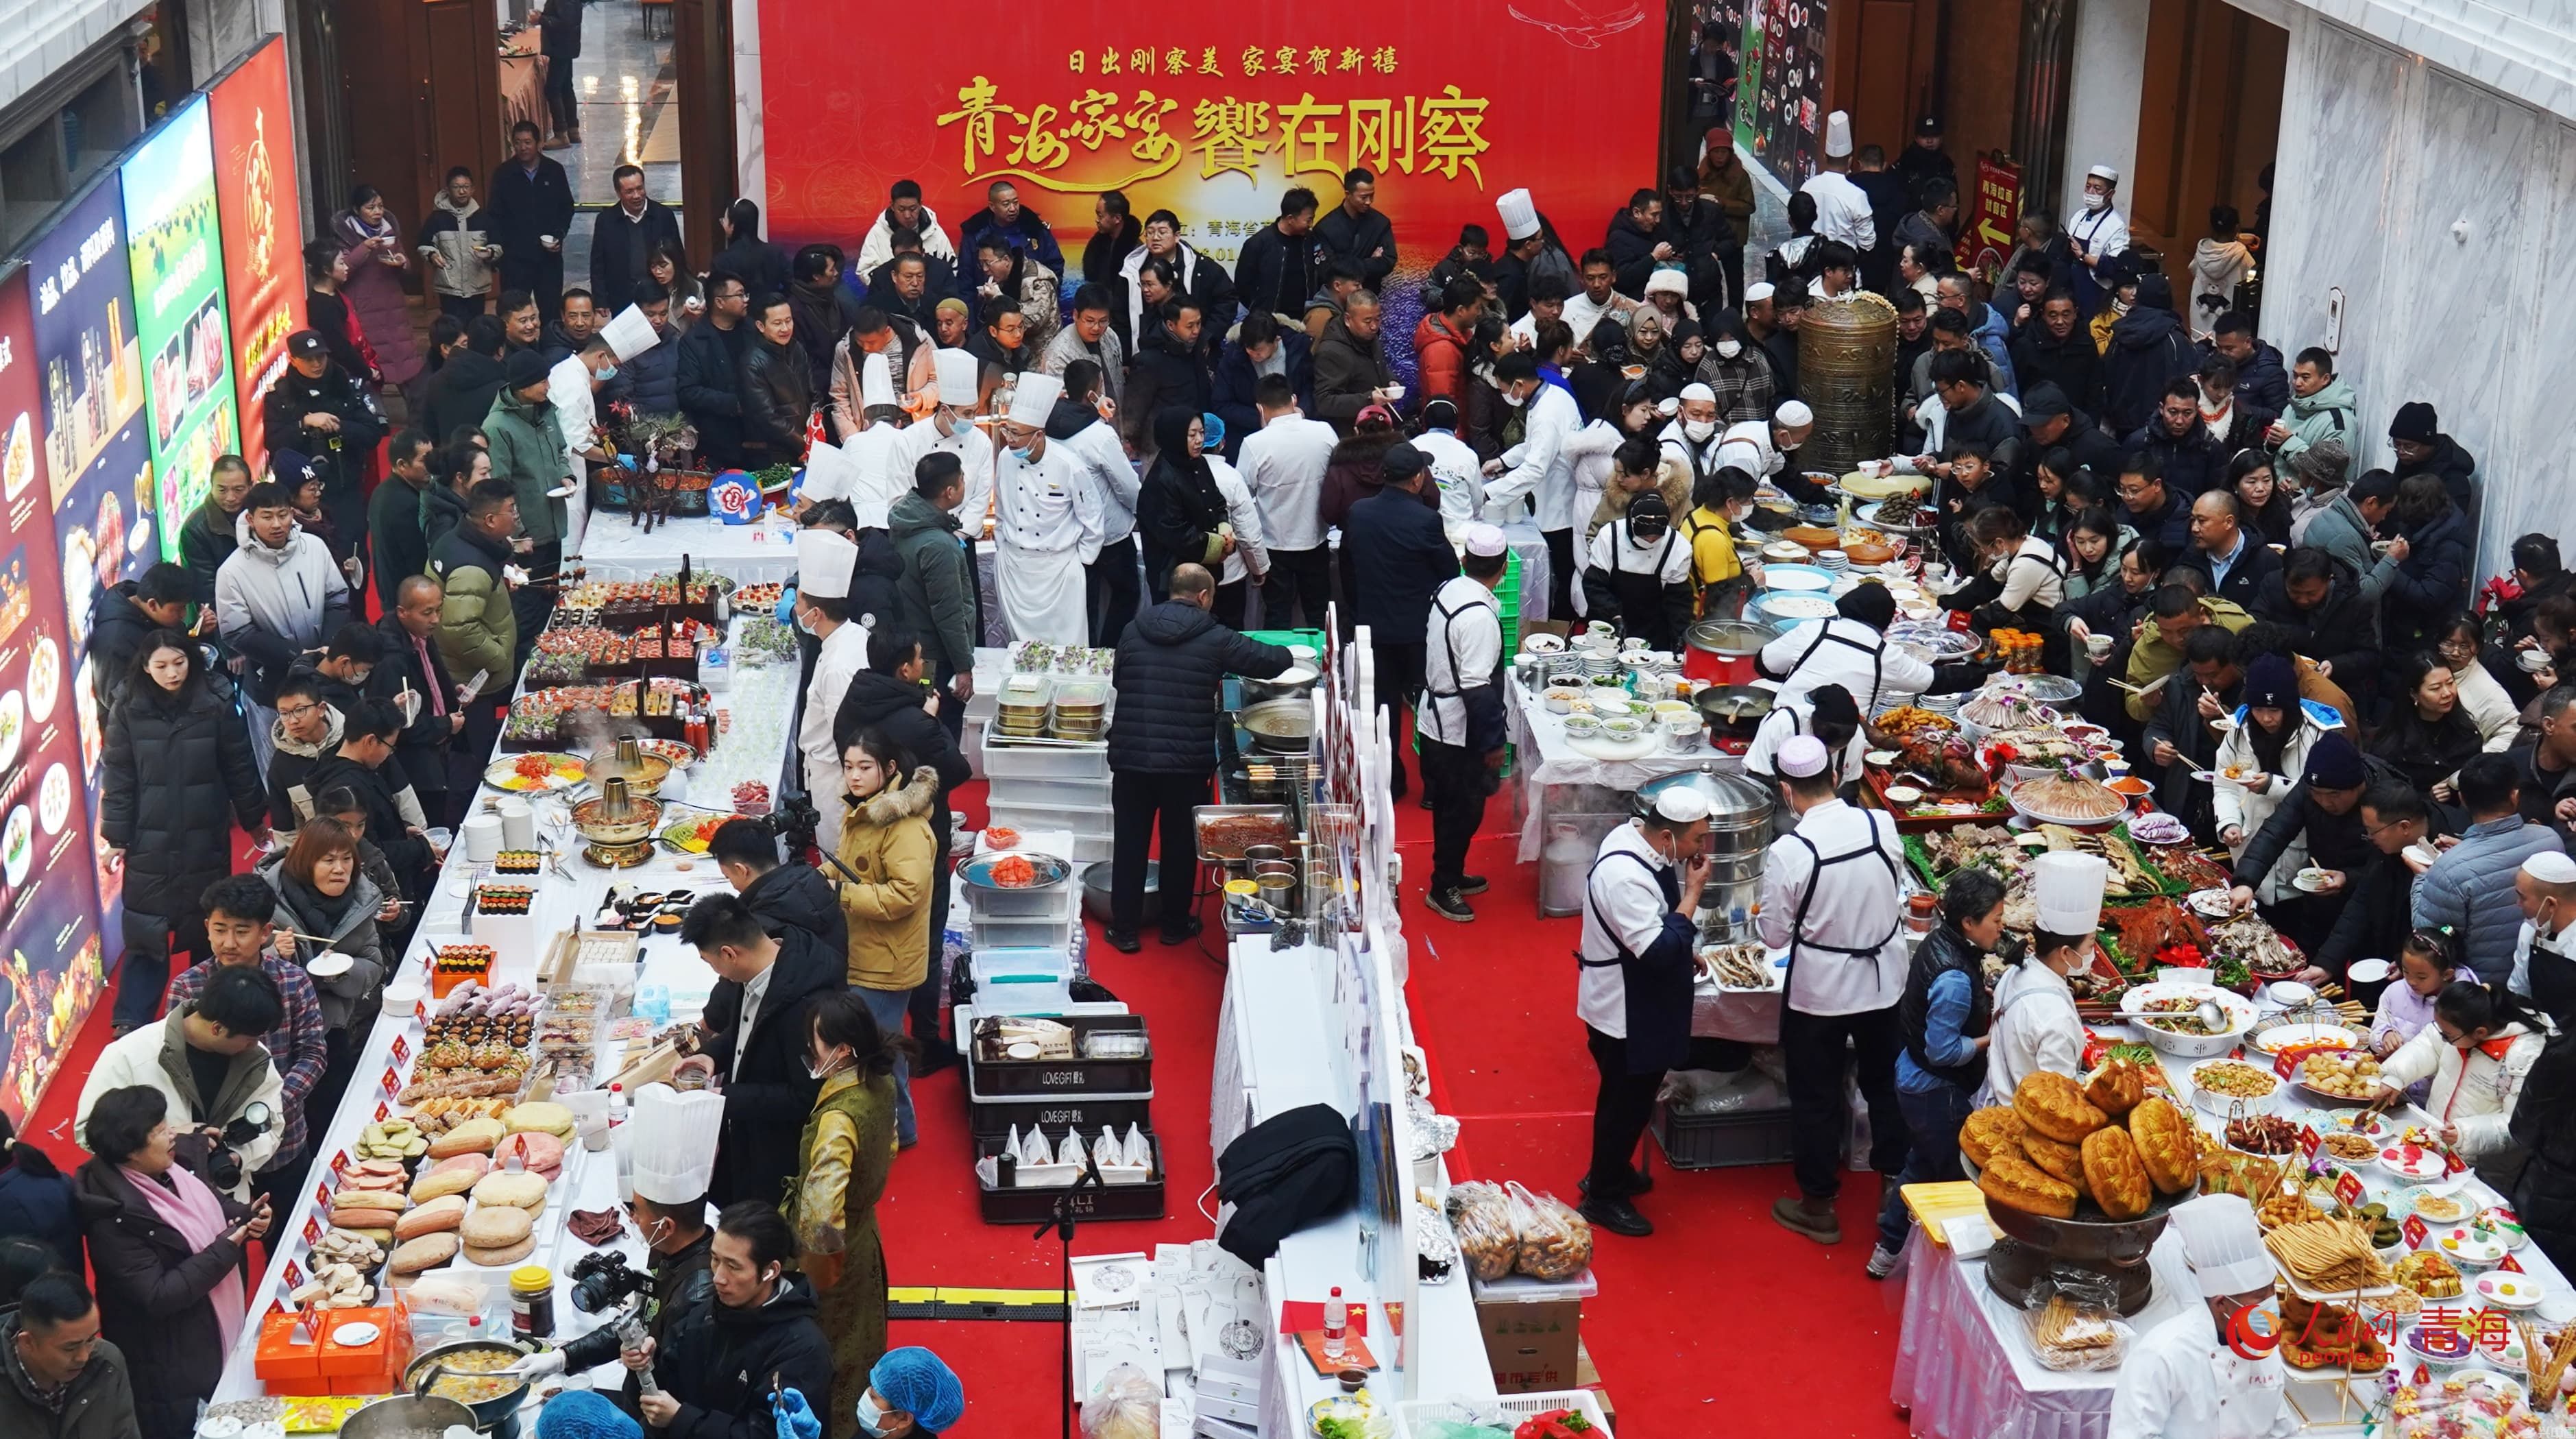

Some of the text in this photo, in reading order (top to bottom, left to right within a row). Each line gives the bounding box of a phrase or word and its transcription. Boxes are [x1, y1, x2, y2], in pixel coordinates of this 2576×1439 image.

[1069, 45, 1400, 77] 日出刚察美 家宴贺新禧
[936, 76, 1183, 192] 青海家宴
[1043, 1072, 1072, 1085] LOVEGIFT
[1041, 1110, 1071, 1123] LOVEGIFT
